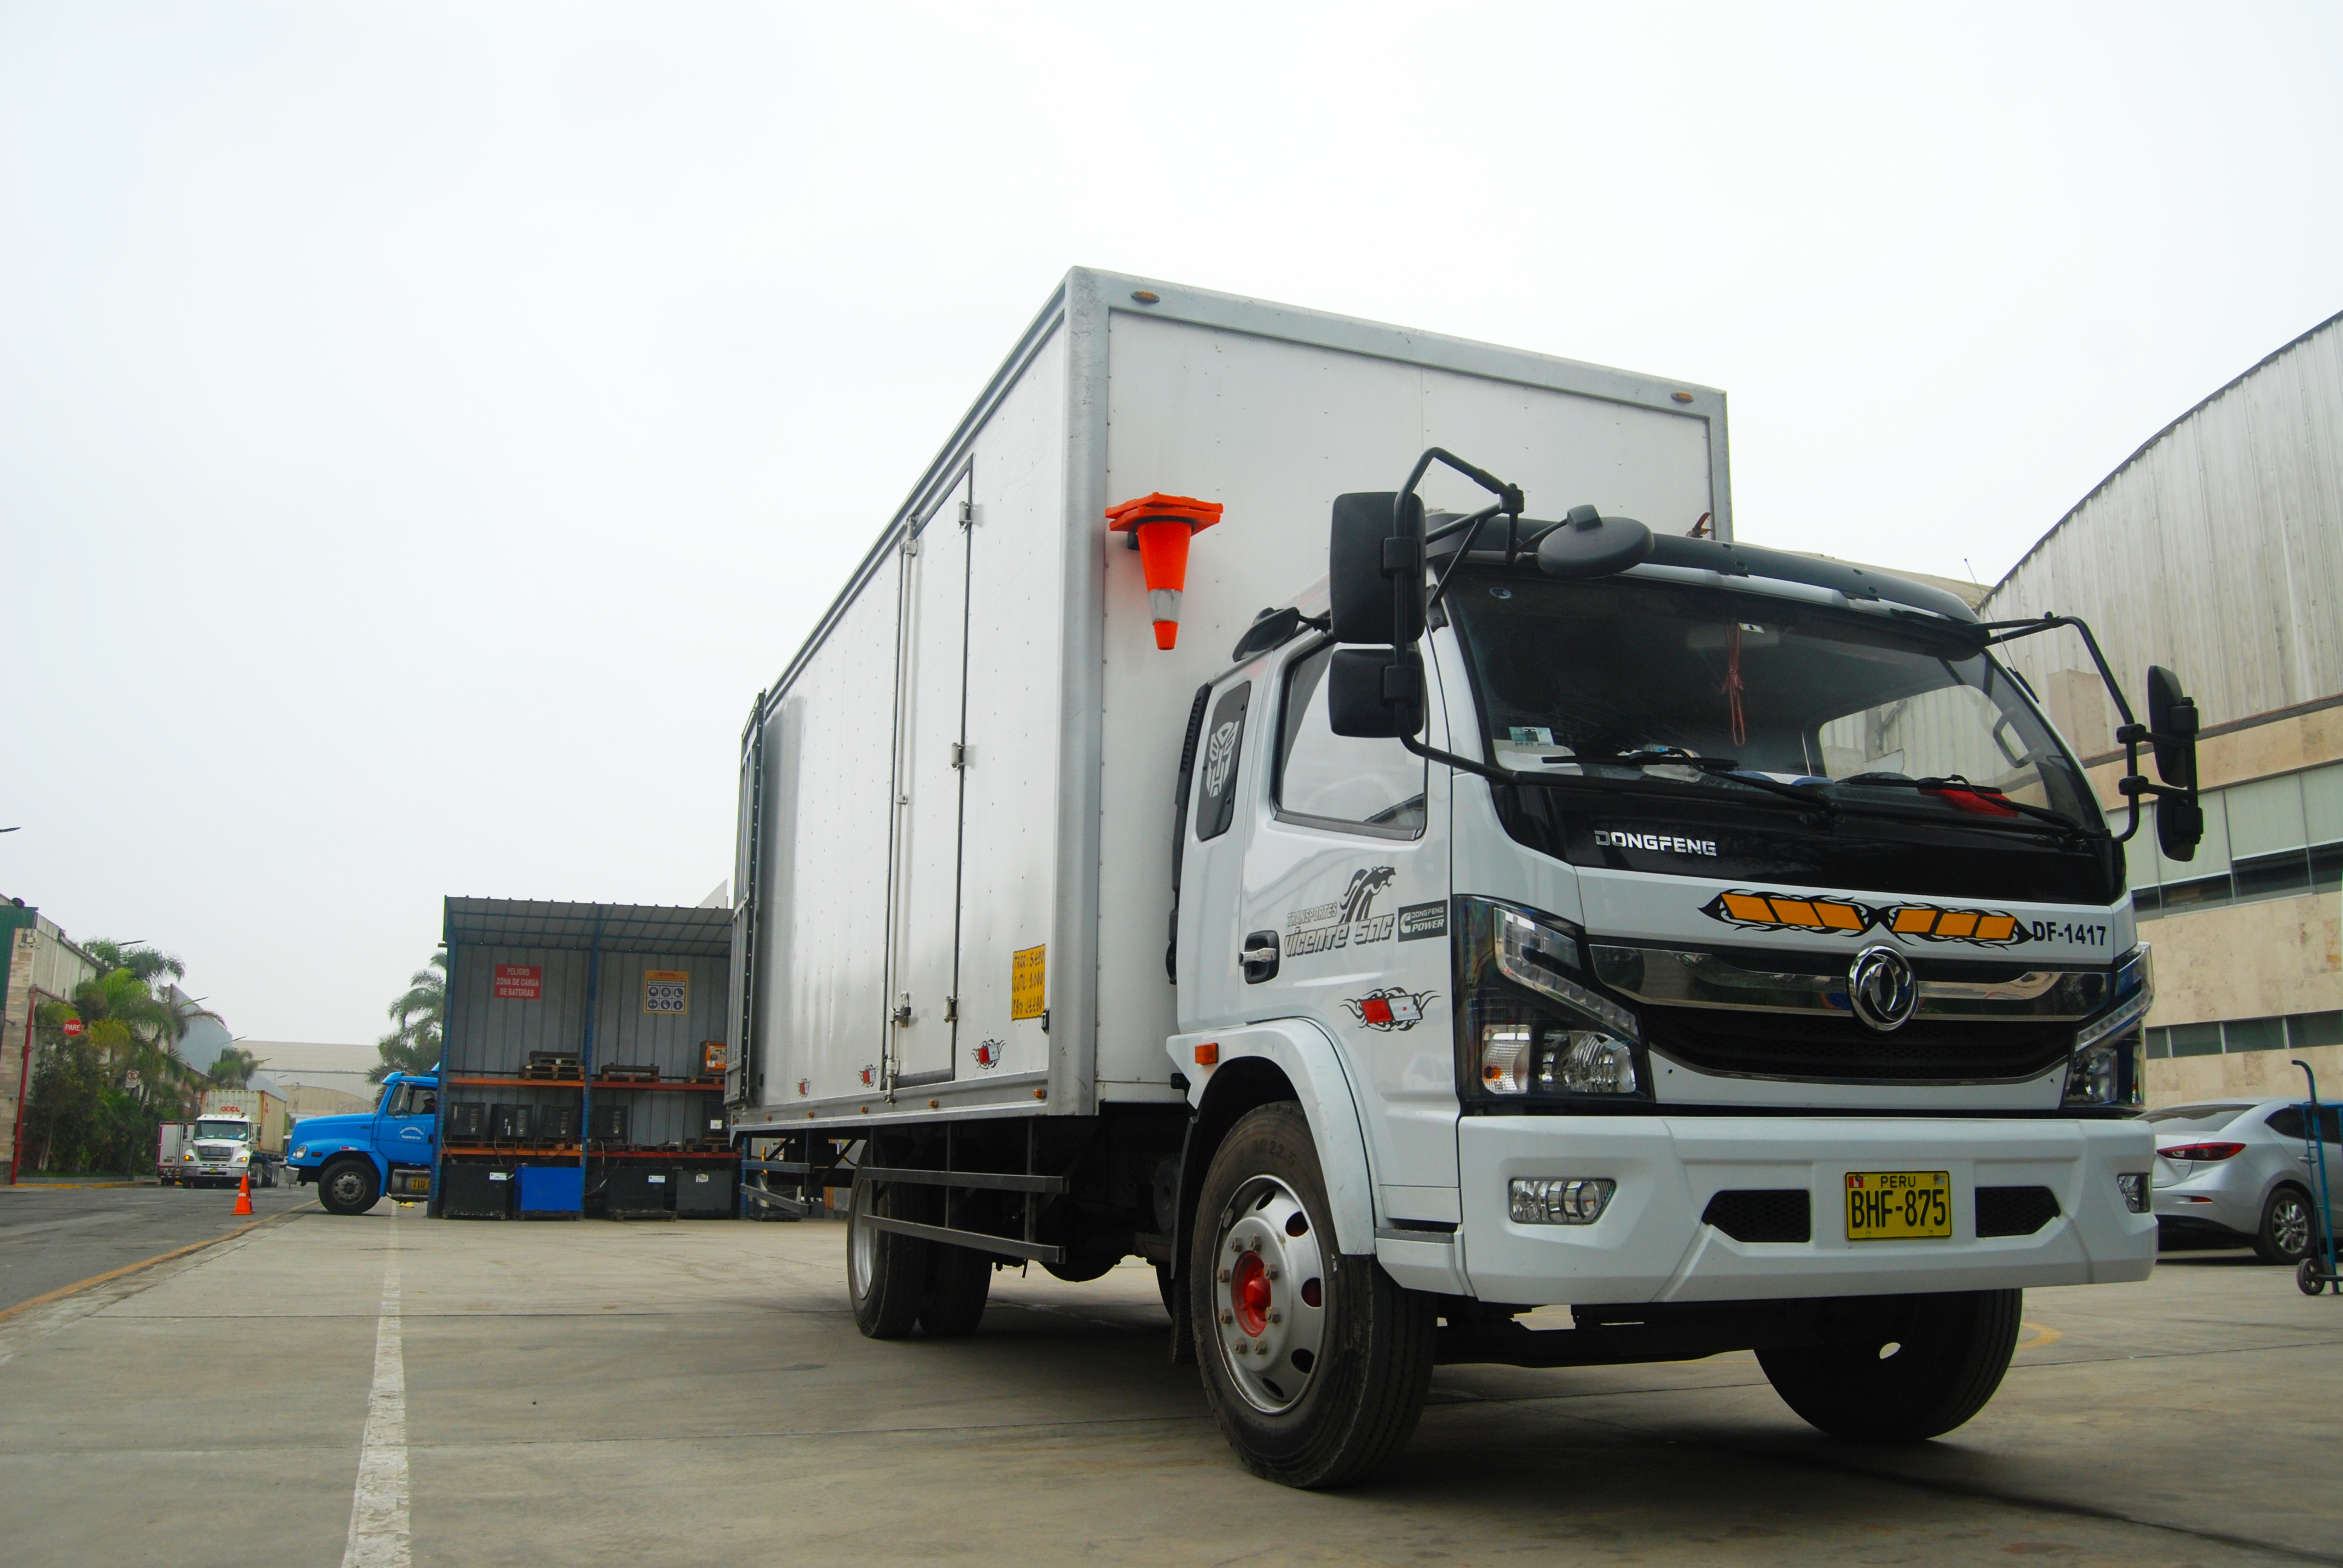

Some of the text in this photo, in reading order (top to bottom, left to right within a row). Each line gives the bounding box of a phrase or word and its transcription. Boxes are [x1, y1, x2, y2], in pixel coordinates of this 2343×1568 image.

[1594, 830, 1717, 857] DONGFENG
[1287, 902, 1338, 927] TRANSPORTES
[1411, 906, 1444, 920] DONGFENG
[1411, 918, 1444, 933] POWER
[2032, 921, 2106, 946] DF-1417
[507, 967, 530, 976] PELIGRO
[496, 977, 539, 987] ZONA DE CARGA
[500, 987, 534, 997] DE BATERIAS
[1880, 1175, 1916, 1188] PERU
[1851, 1189, 1946, 1228] BHF-875
